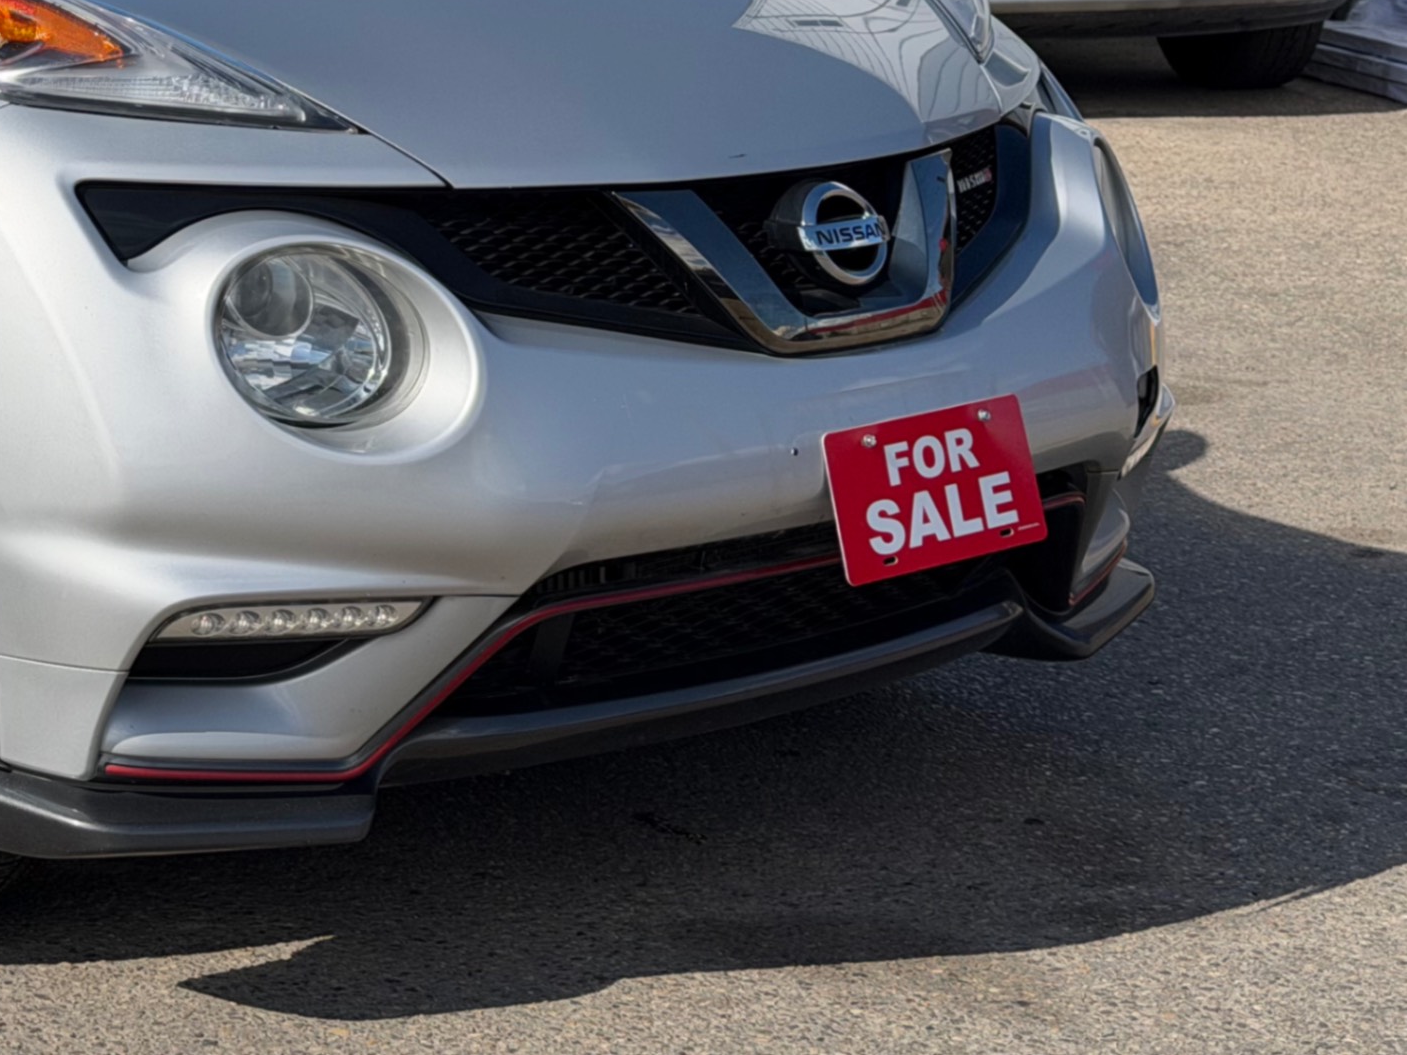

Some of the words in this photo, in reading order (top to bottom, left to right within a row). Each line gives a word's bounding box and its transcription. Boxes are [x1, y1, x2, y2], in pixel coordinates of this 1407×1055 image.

[816, 222, 887, 246] NISSAN
[883, 428, 981, 487] FOR
[866, 471, 1020, 556] SALE
